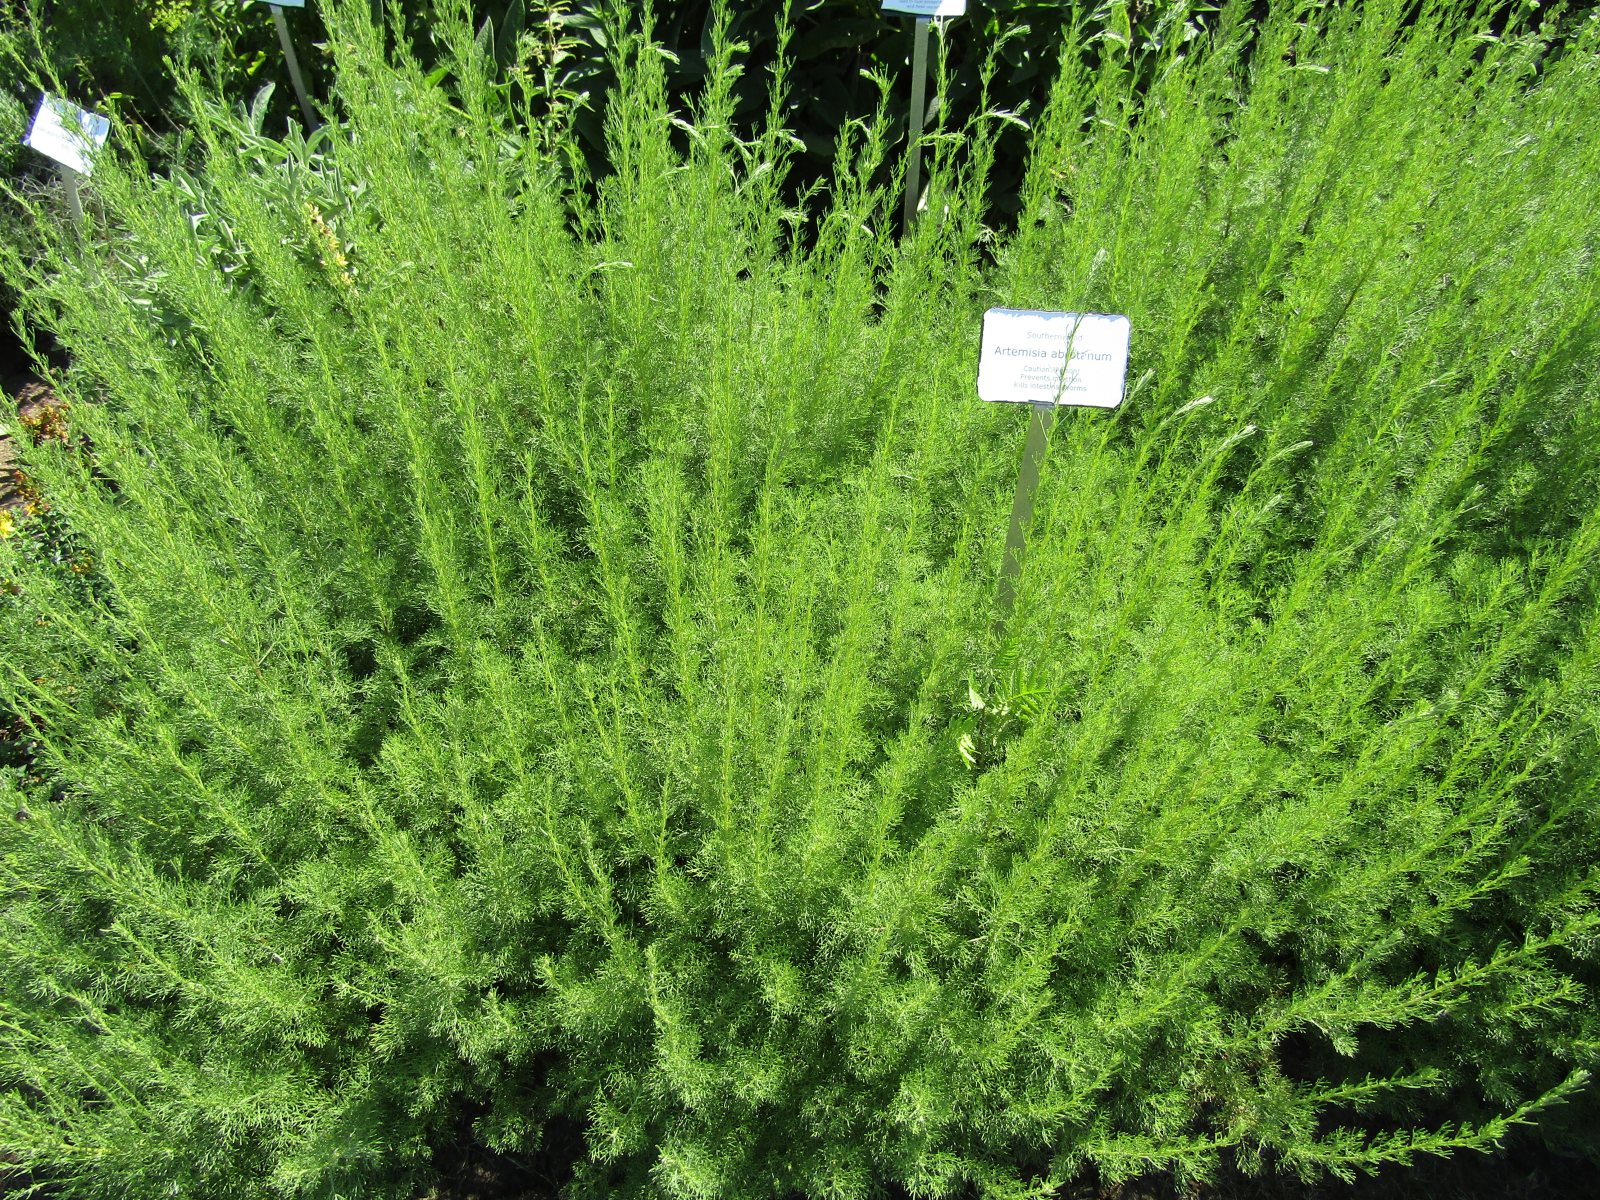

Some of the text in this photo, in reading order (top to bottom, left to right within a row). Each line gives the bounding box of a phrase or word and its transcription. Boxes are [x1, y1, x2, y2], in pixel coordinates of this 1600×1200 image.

[1027, 331, 1083, 342] Southernod
[994, 346, 1112, 361] Artemisia abotanum
